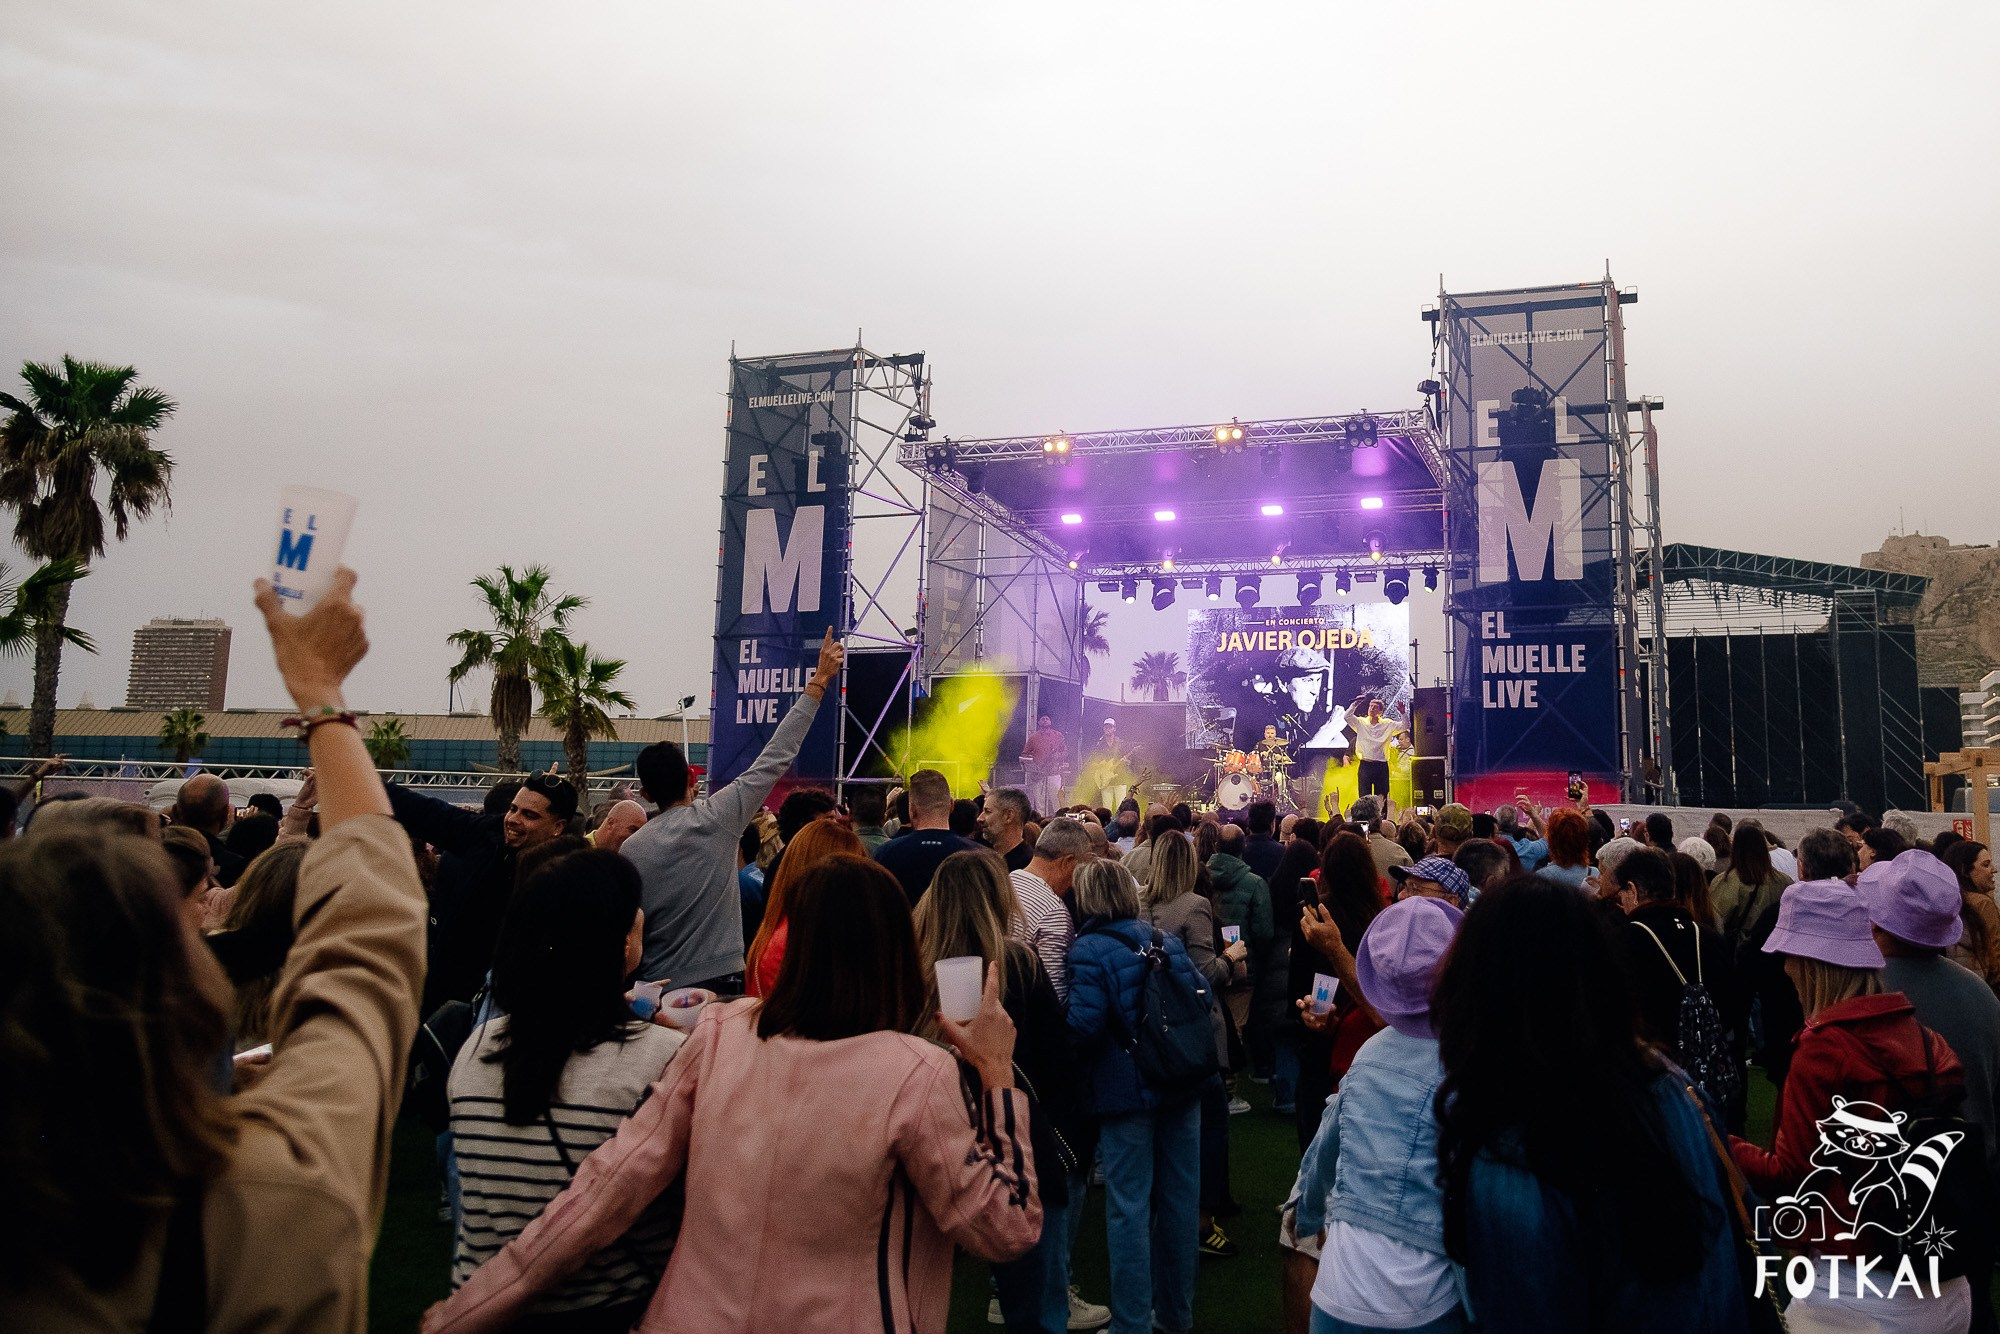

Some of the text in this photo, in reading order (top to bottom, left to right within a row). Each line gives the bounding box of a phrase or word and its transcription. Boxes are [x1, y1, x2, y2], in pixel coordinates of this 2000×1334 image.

[1470, 328, 1584, 347] ELMUELLELIVE.COM
[748, 390, 836, 409] ELMUELLELIVE.COM
[748, 450, 826, 497] E L
[1477, 458, 1583, 582] M
[277, 528, 314, 571] M
[741, 504, 825, 615] M
[1278, 617, 1326, 626] CONCIERTO
[1481, 611, 1511, 639] EL
[739, 639, 762, 664] EL
[1216, 628, 1375, 653] JAVIER OJEDA
[1482, 644, 1586, 674] MUELLE
[1482, 679, 1538, 709] LIVE
[736, 698, 778, 724] LIVE
